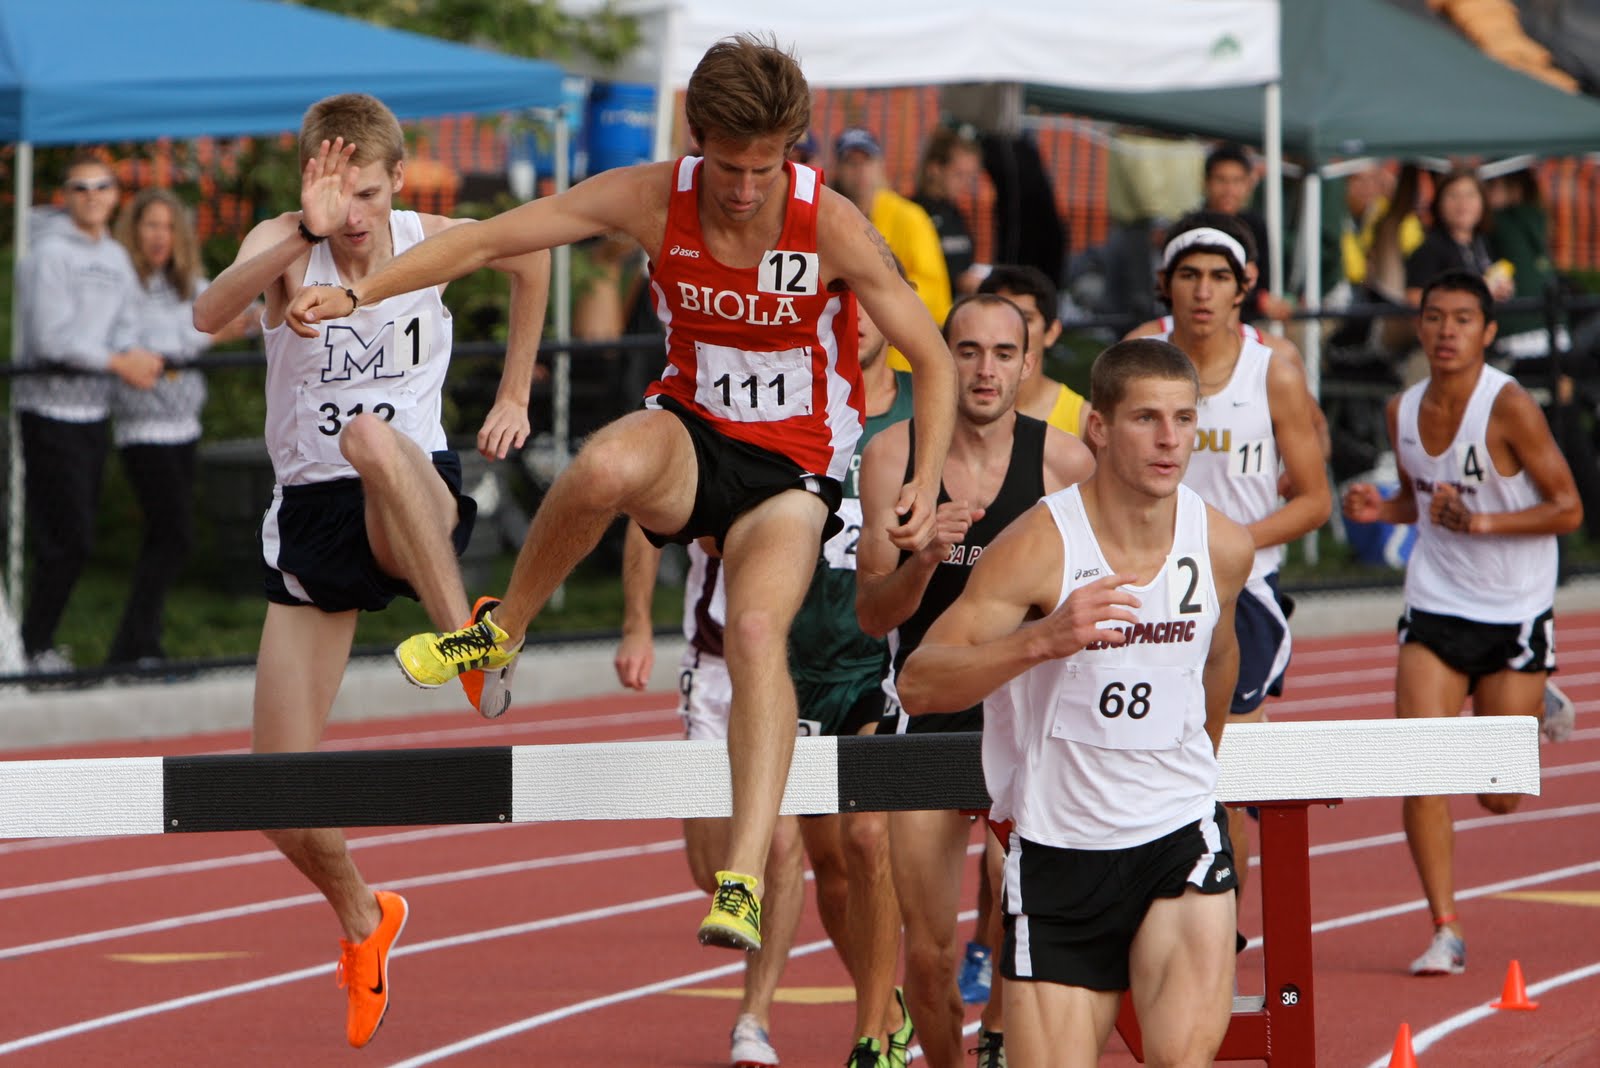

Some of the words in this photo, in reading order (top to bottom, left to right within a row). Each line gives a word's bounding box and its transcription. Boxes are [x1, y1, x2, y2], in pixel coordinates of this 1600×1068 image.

[678, 247, 700, 259] asics
[769, 252, 807, 293] 12
[677, 281, 801, 325] BIOLA
[320, 320, 404, 383] M
[404, 317, 420, 366] 1
[714, 373, 786, 409] 111
[1239, 441, 1262, 474] 11
[1464, 444, 1484, 482] 4
[1177, 556, 1203, 614] 2
[1099, 681, 1153, 720] 68
[1282, 992, 1298, 1006] 36
